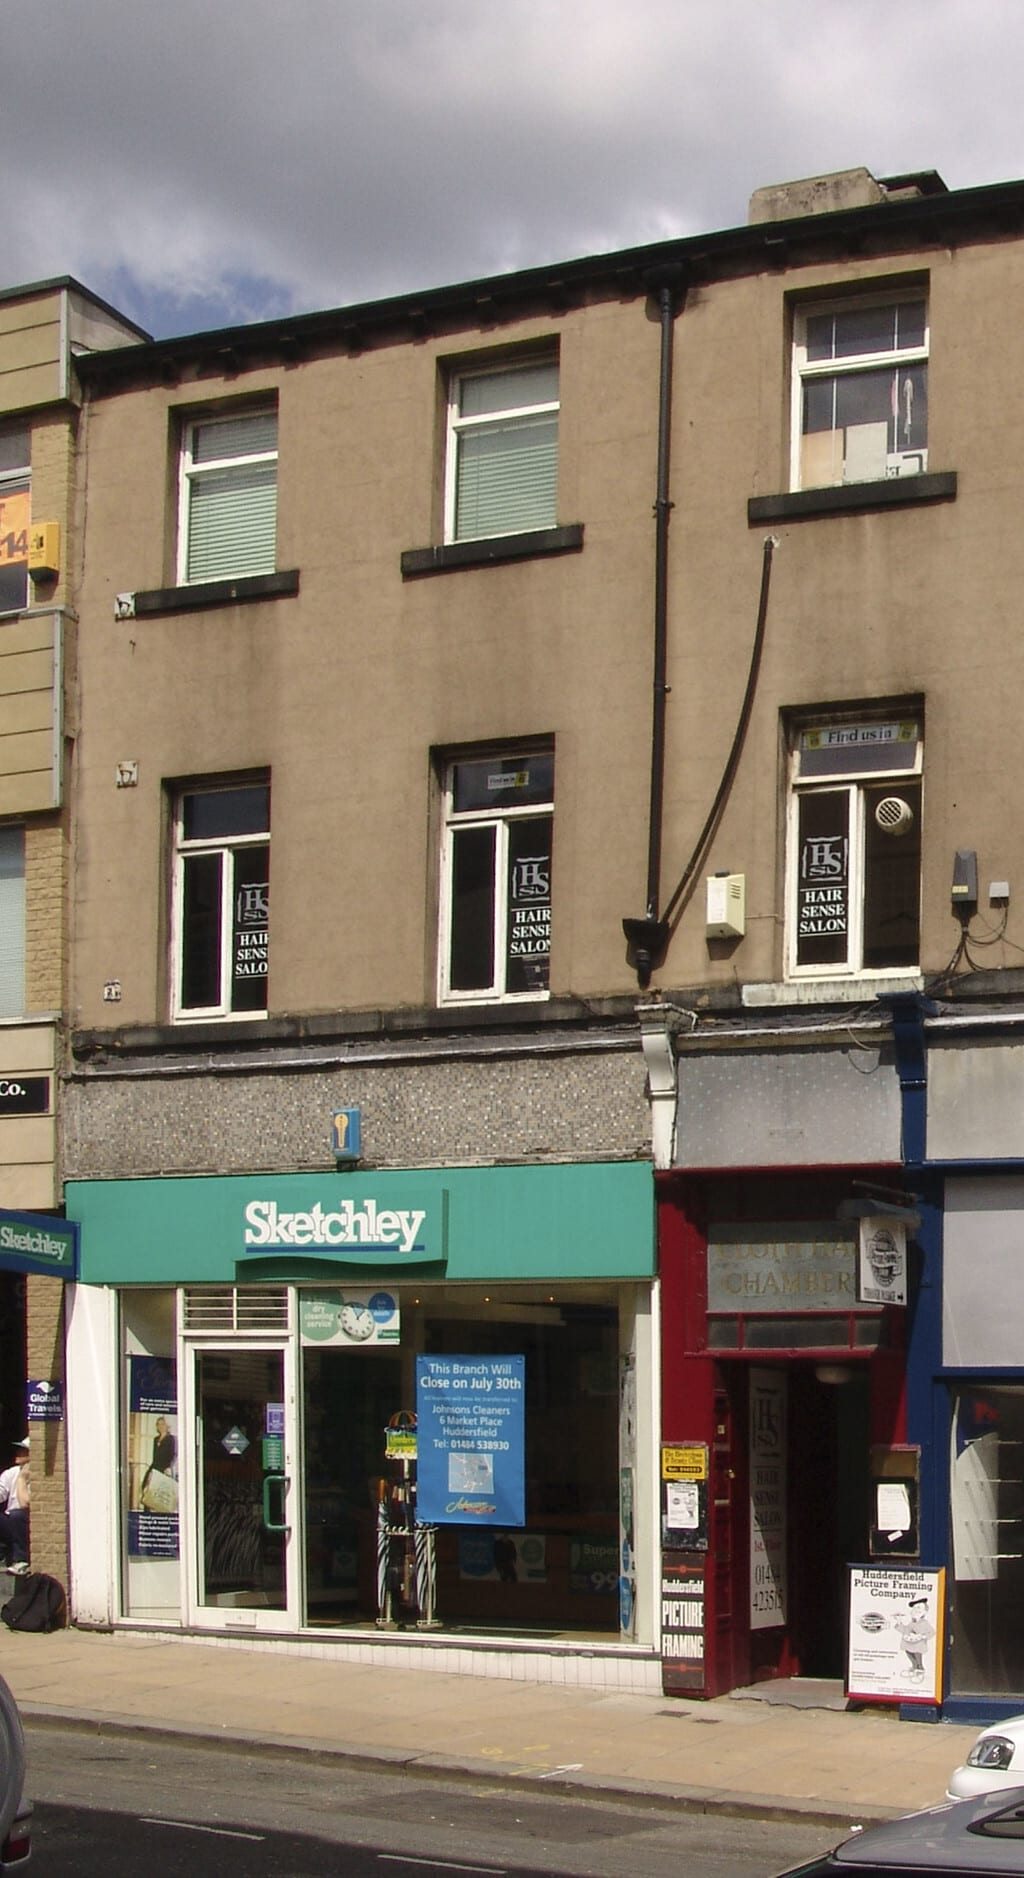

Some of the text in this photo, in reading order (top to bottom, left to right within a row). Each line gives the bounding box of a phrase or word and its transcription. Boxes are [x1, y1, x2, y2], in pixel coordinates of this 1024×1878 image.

[828, 728, 892, 743] Find us in
[805, 889, 843, 903] HAIR
[515, 909, 551, 924] HAIR
[801, 903, 846, 918] SENSE
[799, 918, 847, 933] SALON
[237, 947, 268, 961] SENS
[244, 1199, 426, 1252] Sketchley
[0, 1226, 67, 1260] Sketchley
[723, 1271, 857, 1295] CHAMBER
[429, 1363, 512, 1374] This Branch Will
[420, 1376, 521, 1392] Close on July 30th
[30, 1393, 60, 1403] Global
[27, 1403, 62, 1412] Travels
[432, 1404, 510, 1415] Johnsons Cleaners
[439, 1416, 503, 1426] 6 Market Place
[442, 1427, 497, 1437] Huddersfield
[432, 1439, 449, 1448] Tel:
[862, 1570, 925, 1581] Huddersfield
[854, 1579, 933, 1592] Picture Framing
[870, 1588, 917, 1599] Company
[662, 1601, 704, 1627] PICTURE
[662, 1634, 704, 1658] FRAMING
